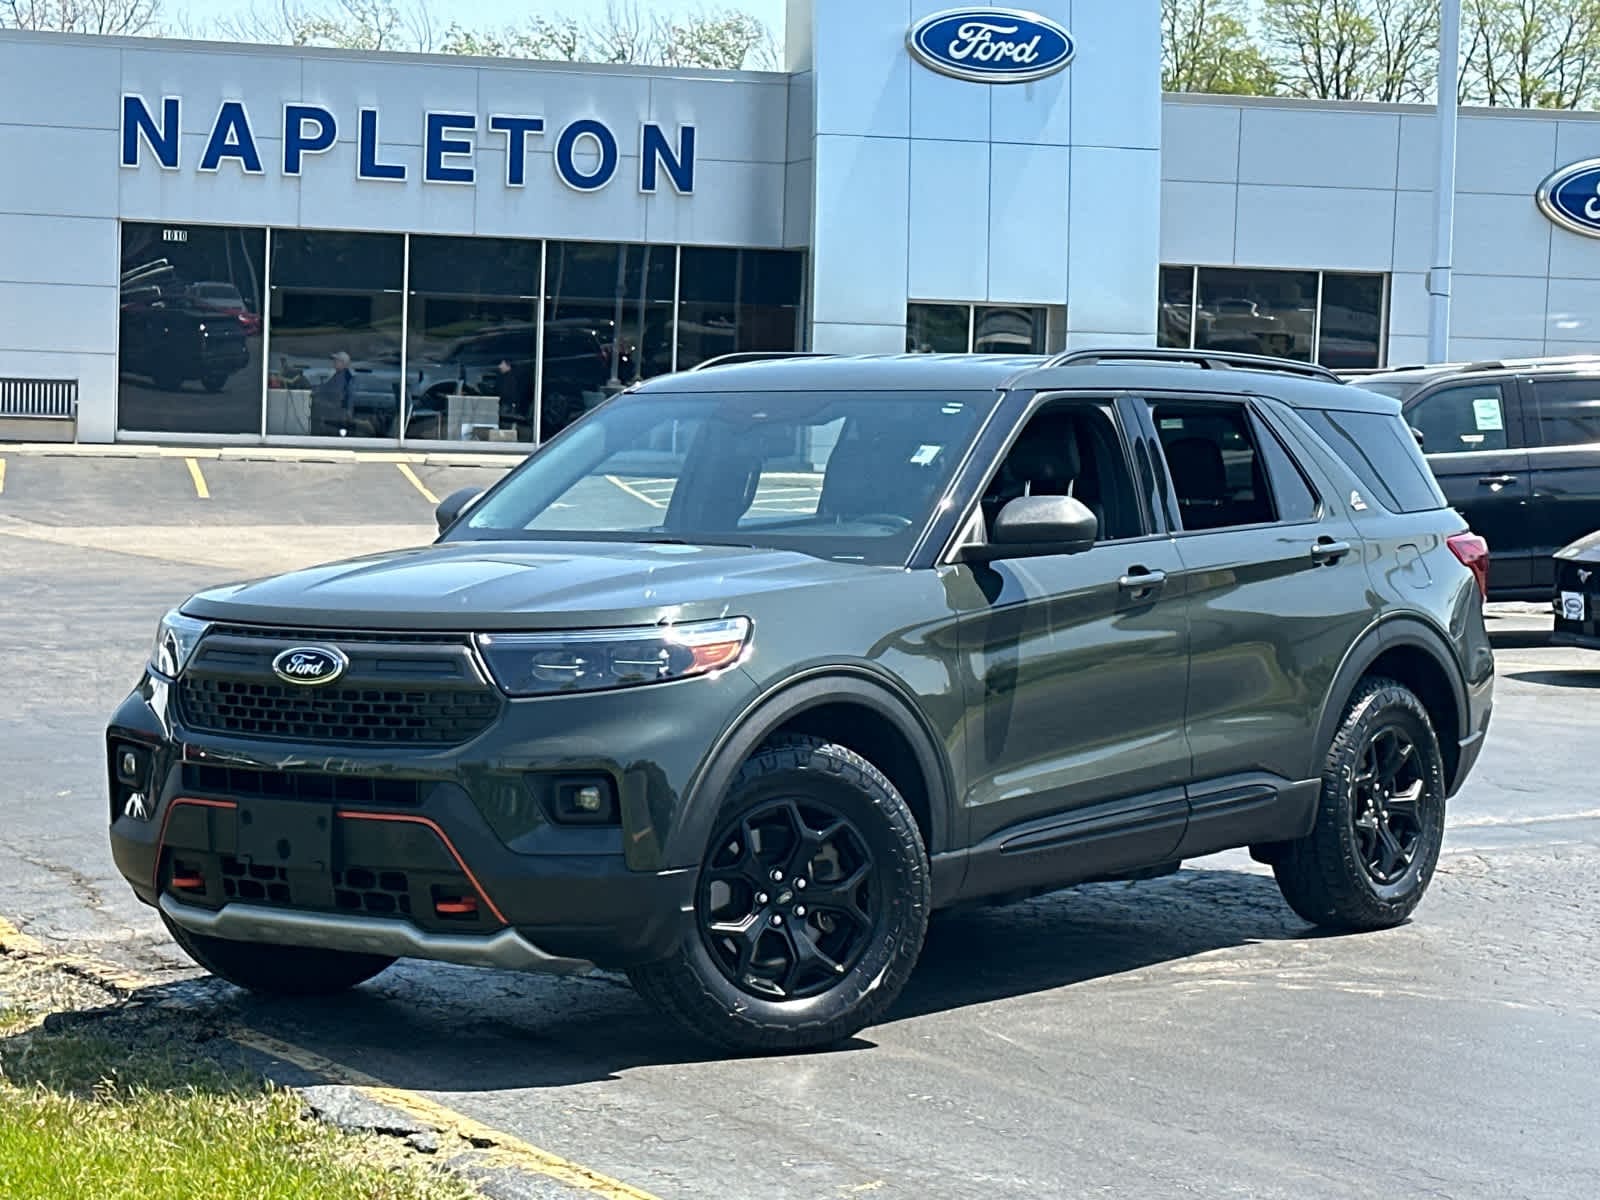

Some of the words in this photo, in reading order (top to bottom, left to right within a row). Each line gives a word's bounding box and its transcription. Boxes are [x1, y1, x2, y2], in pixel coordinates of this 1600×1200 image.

[949, 22, 1041, 63] Ford
[119, 93, 696, 194] NAPLETON
[163, 229, 188, 241] 1010
[286, 653, 324, 675] Ford
